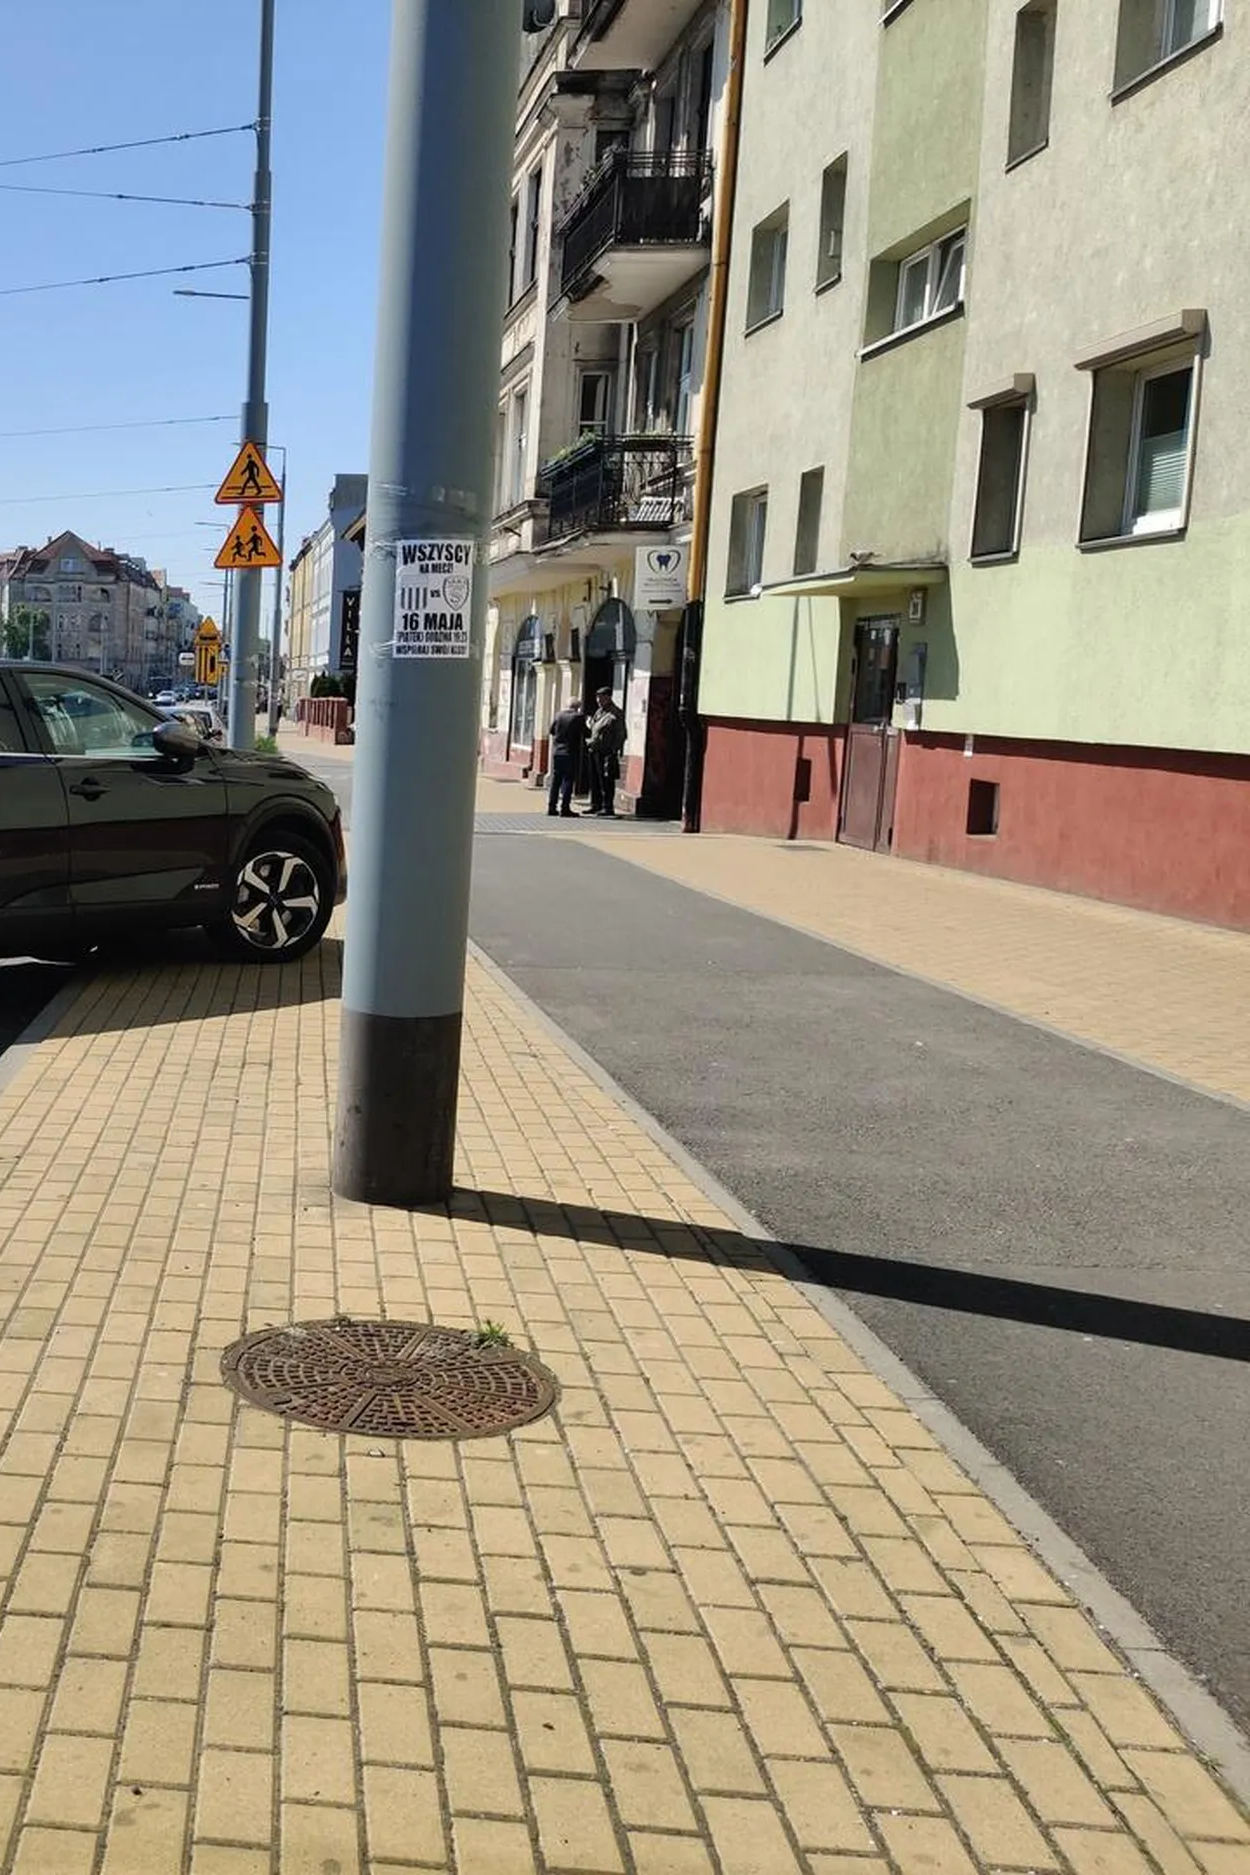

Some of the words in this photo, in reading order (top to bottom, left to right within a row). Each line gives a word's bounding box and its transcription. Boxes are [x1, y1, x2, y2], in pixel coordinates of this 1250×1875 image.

[402, 544, 471, 566] WSZYSCY
[419, 564, 430, 574] NA
[344, 596, 355, 656] VILLA
[402, 613, 419, 630] 16
[424, 613, 463, 630] MAJA
